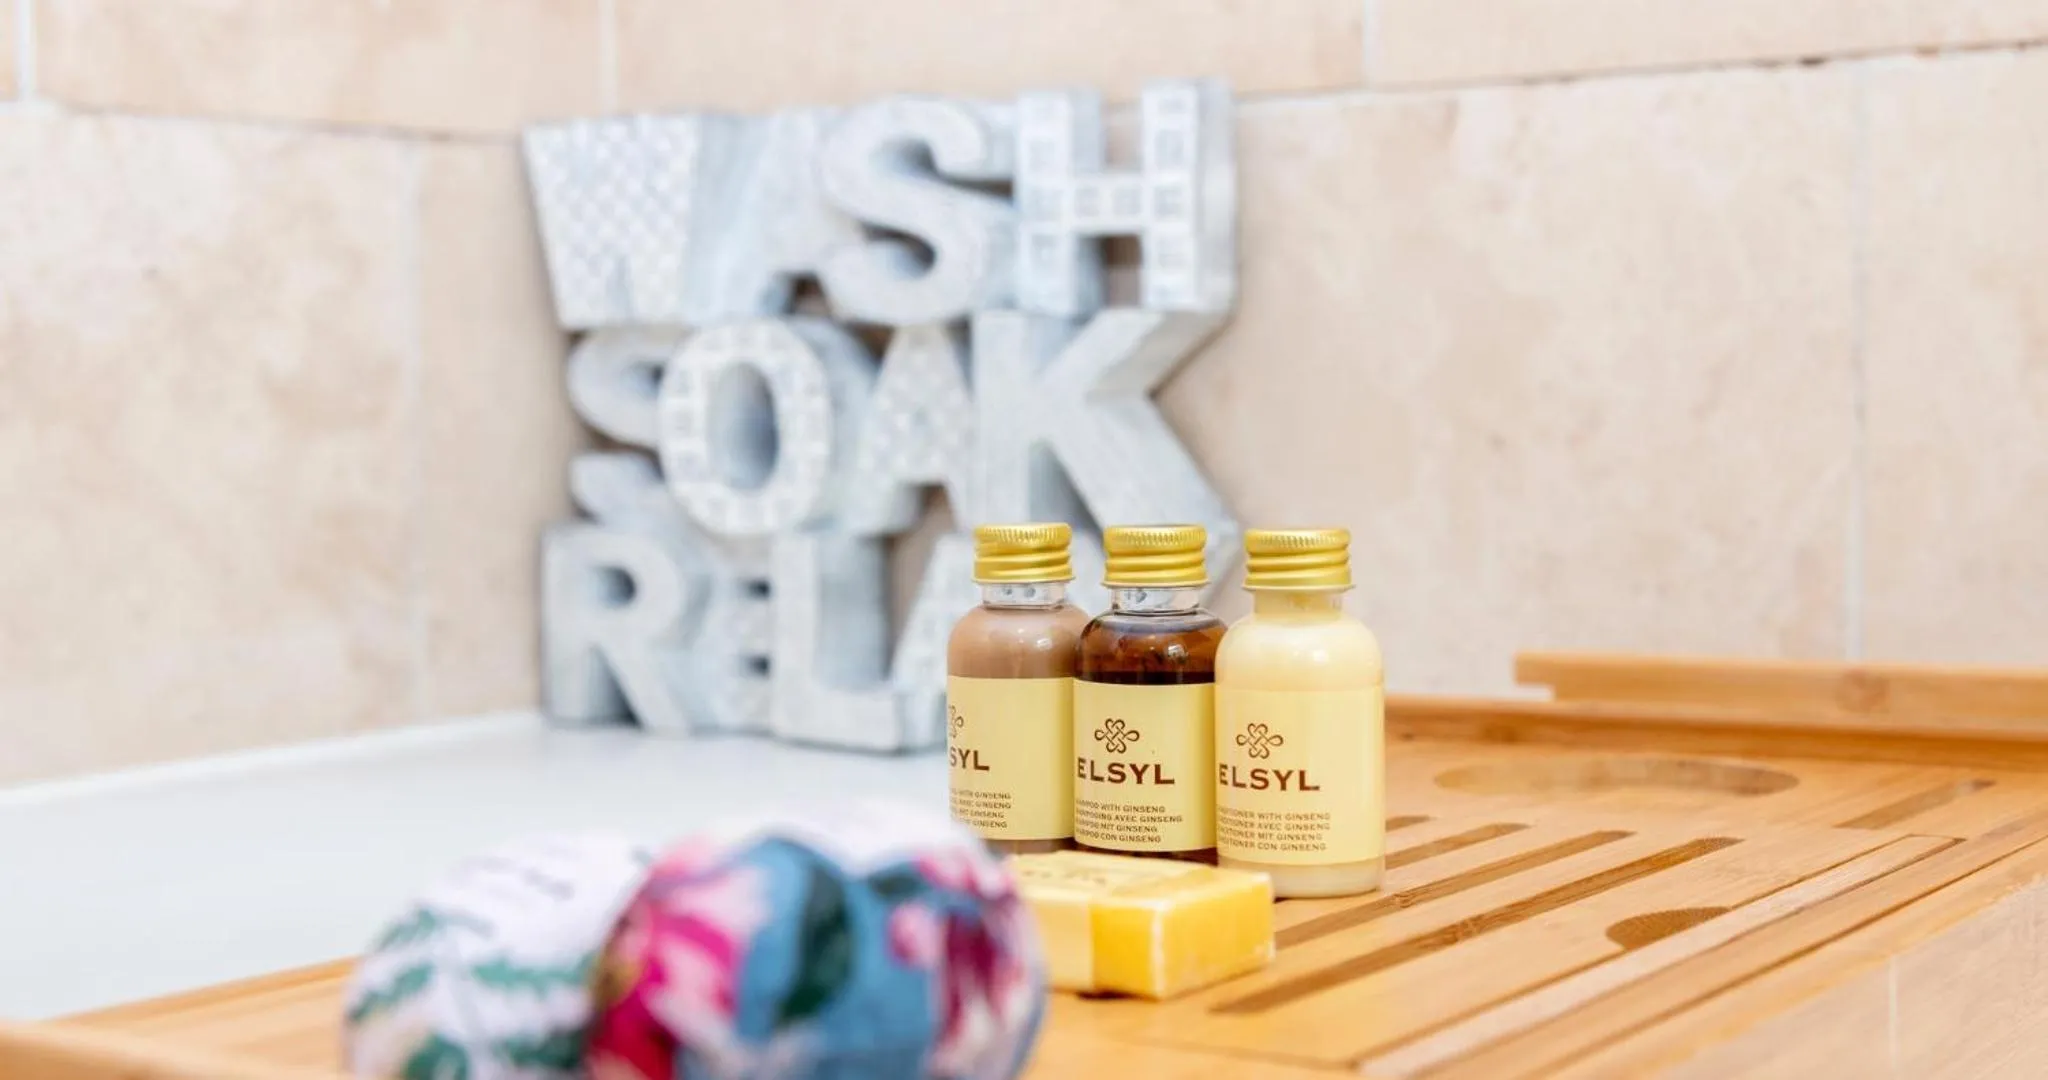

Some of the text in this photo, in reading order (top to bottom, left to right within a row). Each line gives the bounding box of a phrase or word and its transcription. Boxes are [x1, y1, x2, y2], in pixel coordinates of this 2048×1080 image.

[567, 306, 1238, 538] SOAK
[949, 746, 990, 772] SYL
[1077, 757, 1175, 785] ELSYL
[1219, 763, 1321, 792] ELSYL
[1101, 803, 1121, 812] WITH
[1123, 805, 1166, 813] GINSENG
[1114, 814, 1138, 823] AVEC
[1140, 815, 1183, 824] GINSENG
[1257, 812, 1282, 821] WITH
[1285, 812, 1331, 821] GINSENG
[1100, 822, 1115, 831] MIT
[1116, 824, 1158, 833] GINSENG
[1257, 823, 1282, 831] AVEC
[1284, 823, 1330, 831] GINSENG
[1100, 832, 1117, 841] CON
[1119, 834, 1161, 843] GINSENG
[1257, 833, 1273, 841] MIT
[1276, 833, 1323, 841] GINSENG
[1257, 842, 1277, 850] CON
[1280, 843, 1327, 851] GINSENG
